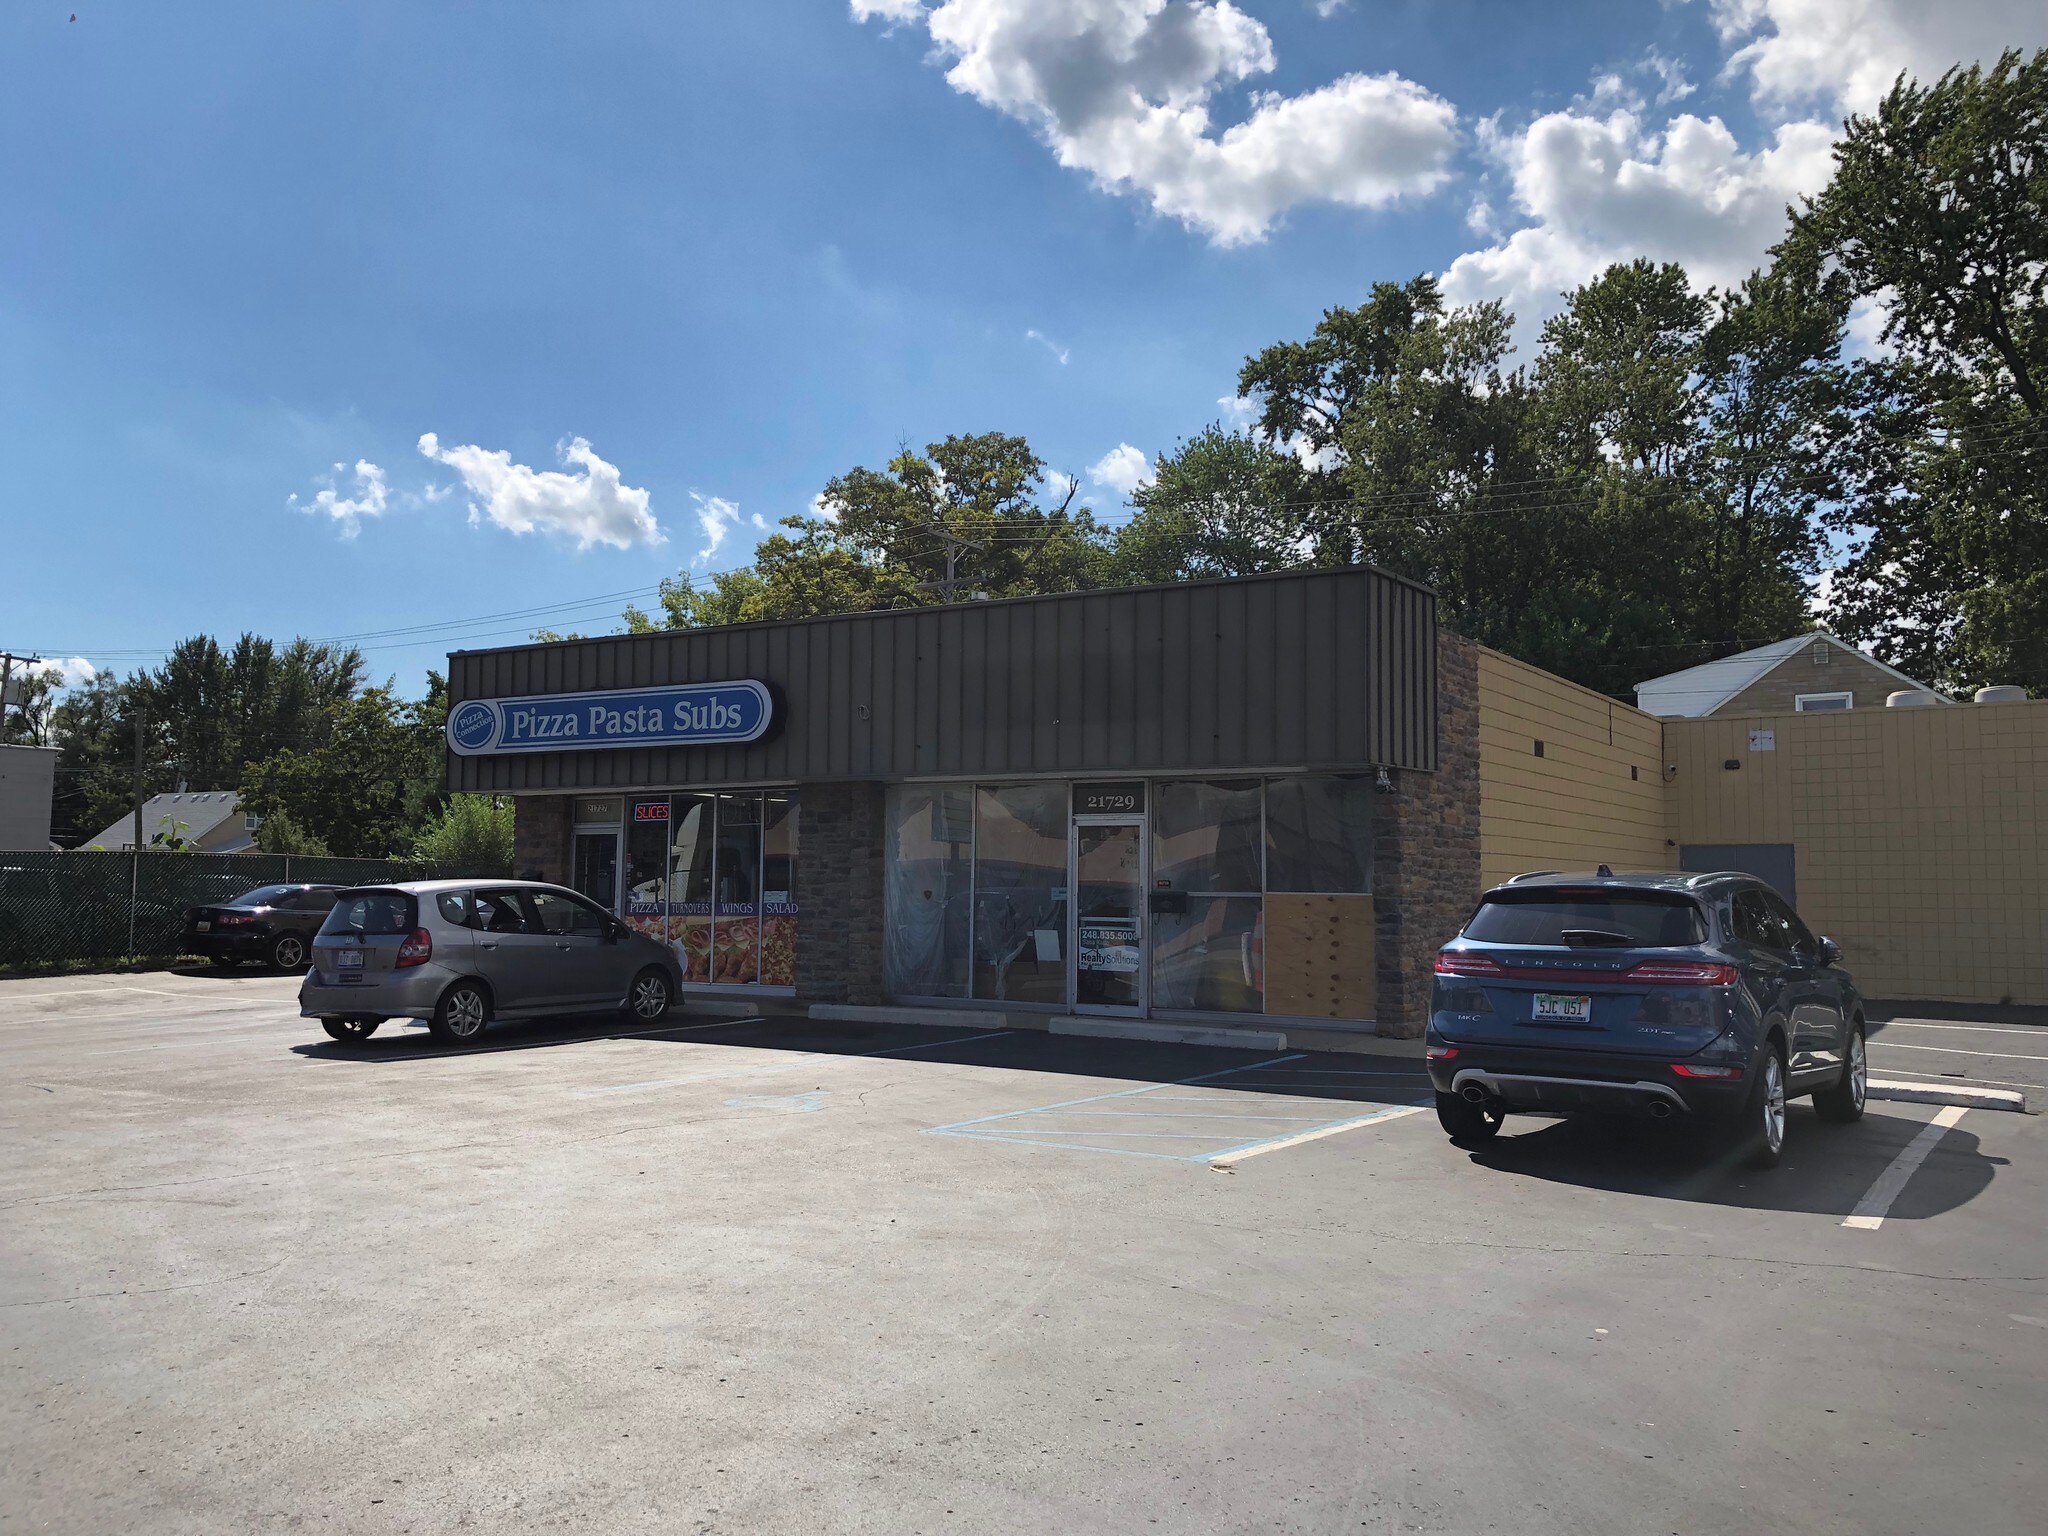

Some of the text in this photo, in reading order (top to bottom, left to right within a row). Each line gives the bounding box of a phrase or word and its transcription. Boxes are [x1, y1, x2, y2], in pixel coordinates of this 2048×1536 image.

[459, 711, 483, 728] Pizza
[512, 696, 742, 739] Pizza Pasta Subs
[456, 715, 494, 739] Connection
[1087, 795, 1135, 811] 21729
[636, 805, 669, 819] SLICES
[630, 902, 799, 914] PIZZA TURNOVERS WINGS SALAD
[1505, 959, 1620, 969] LINCOLN
[1539, 1000, 1582, 1015] 5JC U51
[1458, 1014, 1481, 1022] MKC
